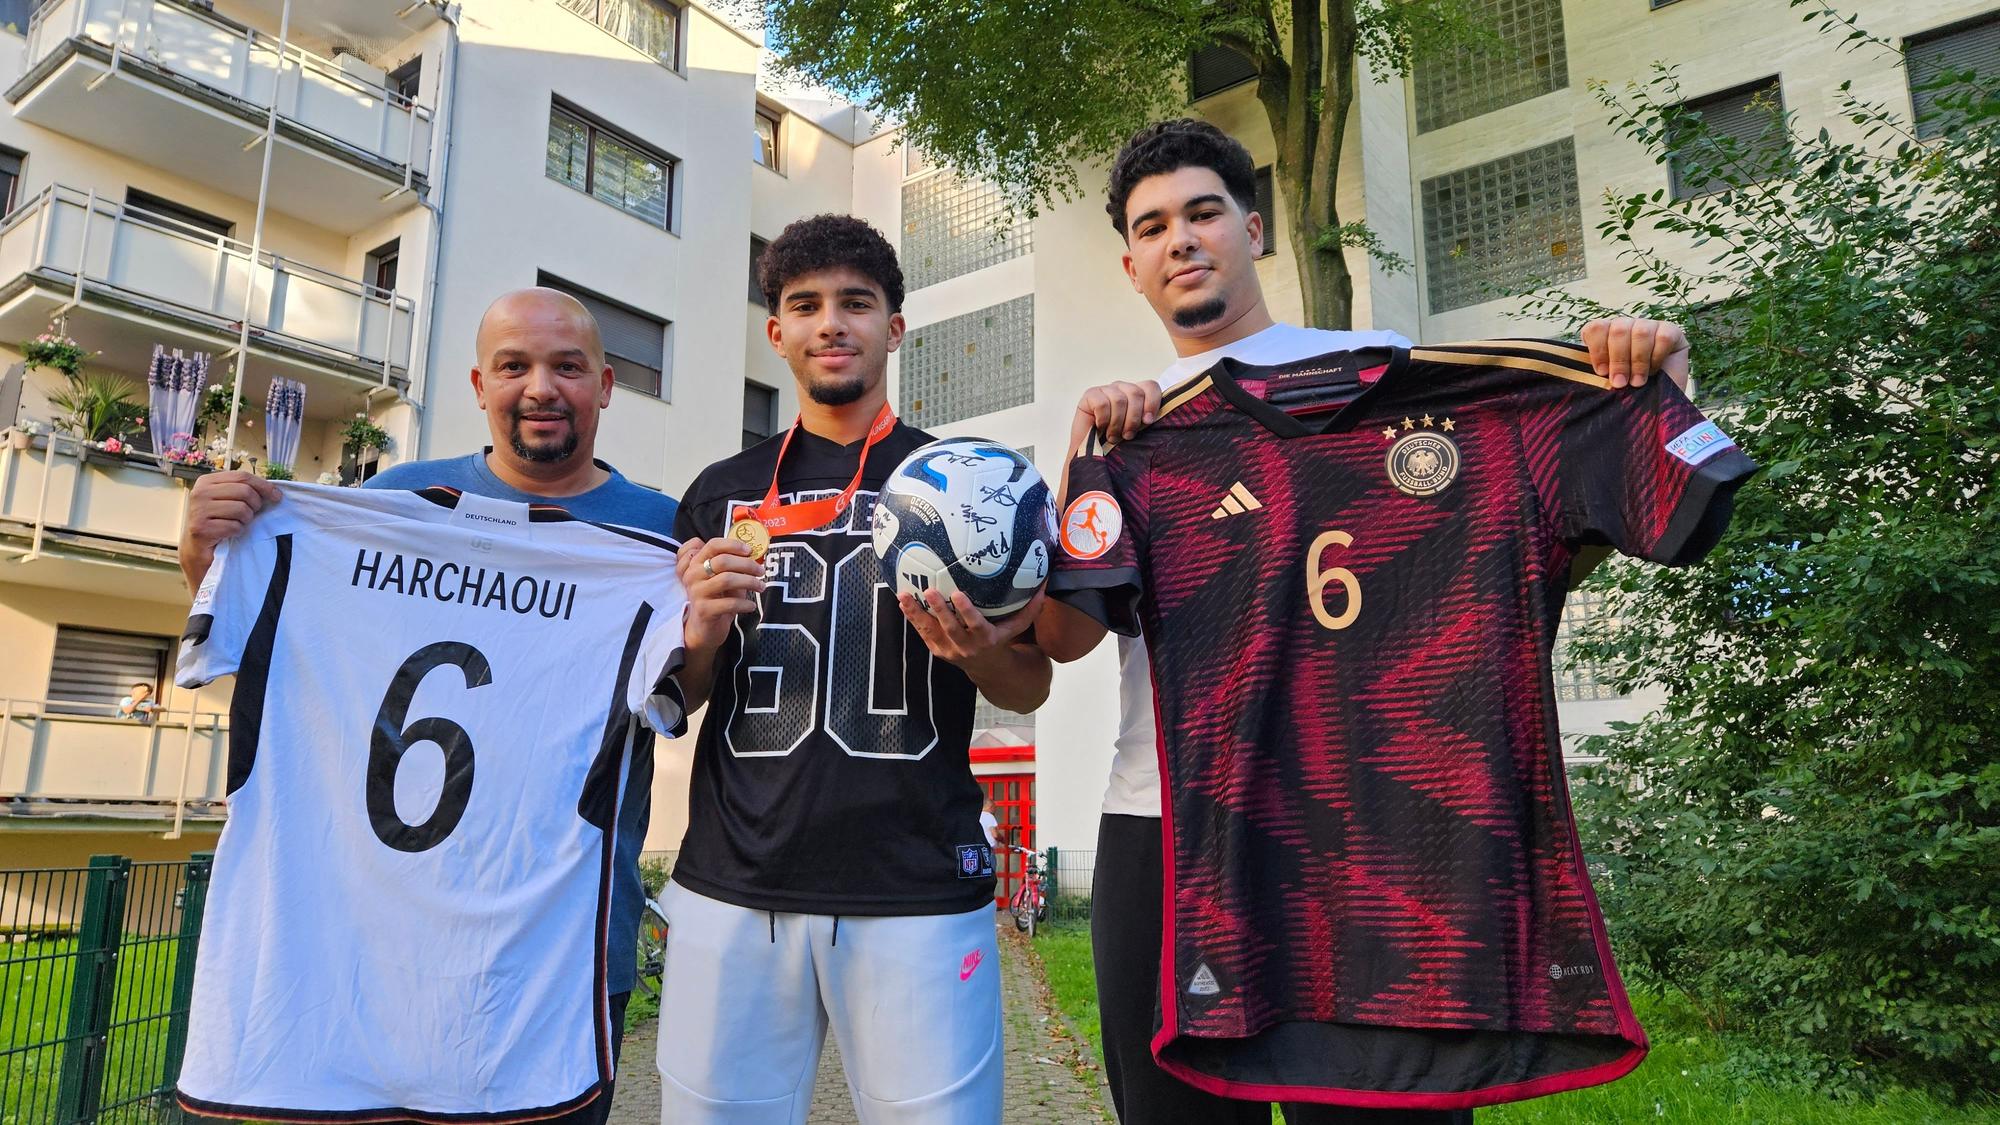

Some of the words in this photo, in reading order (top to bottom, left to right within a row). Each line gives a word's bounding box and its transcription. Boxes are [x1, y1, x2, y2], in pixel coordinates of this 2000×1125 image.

[1292, 366, 1343, 378] MANNSCHAFT
[1401, 440, 1442, 454] DEUTSCHER
[465, 512, 517, 526] DEUTSCHLAND
[763, 517, 787, 528] 2023
[760, 551, 801, 579] ST.
[351, 548, 577, 620] HARCHAOUI
[1306, 530, 1362, 629] 6
[725, 541, 939, 761] 60
[366, 640, 493, 853] 6
[964, 859, 977, 871] NFL
[962, 948, 982, 970] NIKE
